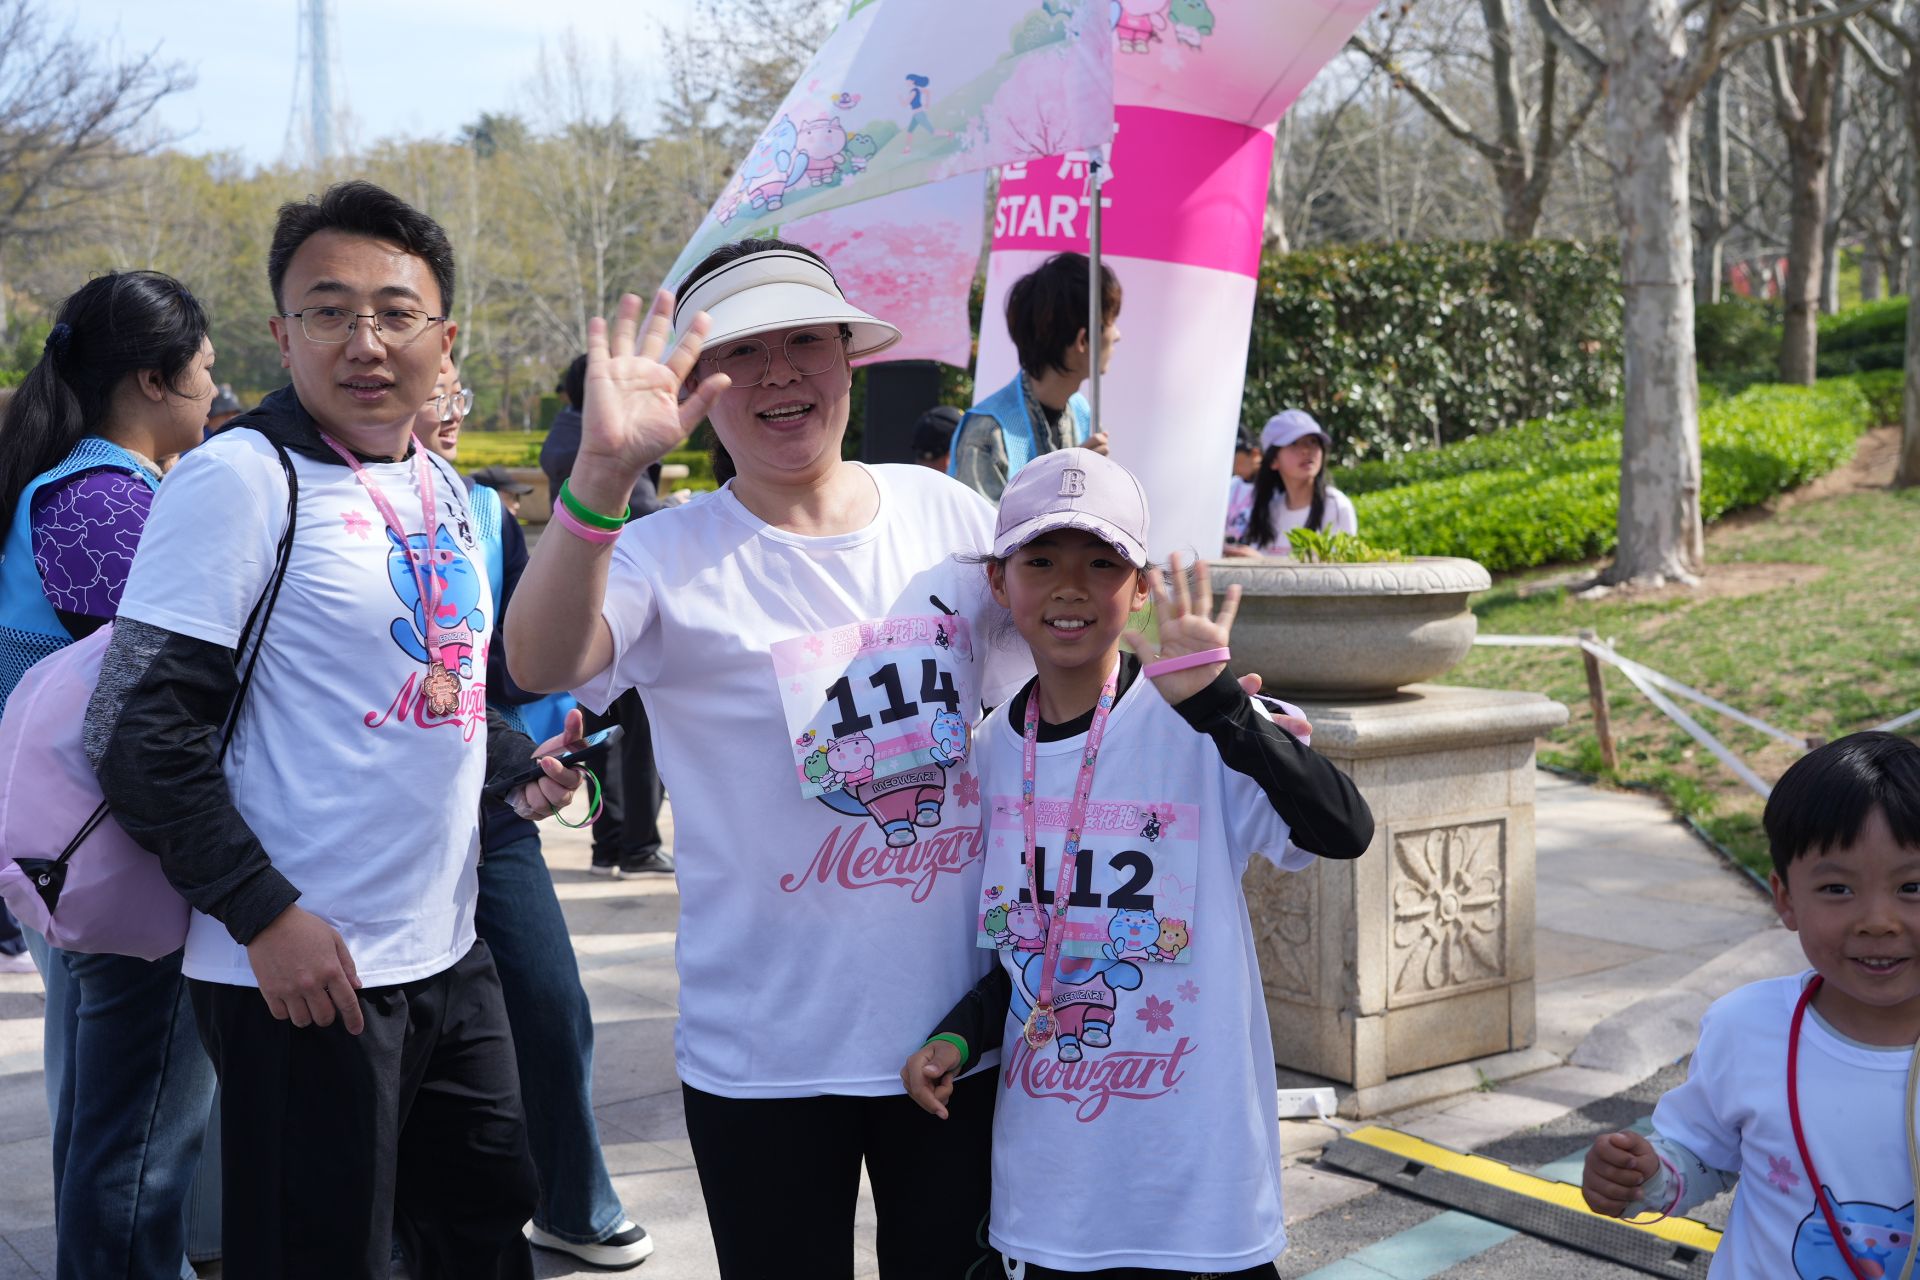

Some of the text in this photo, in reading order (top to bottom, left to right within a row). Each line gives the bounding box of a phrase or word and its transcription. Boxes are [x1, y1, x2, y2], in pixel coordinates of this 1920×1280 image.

[994, 194, 1112, 239] START
[1057, 468, 1087, 498] B
[825, 658, 960, 738] 114
[872, 771, 937, 794] MEOWZART
[1019, 845, 1155, 909] 112
